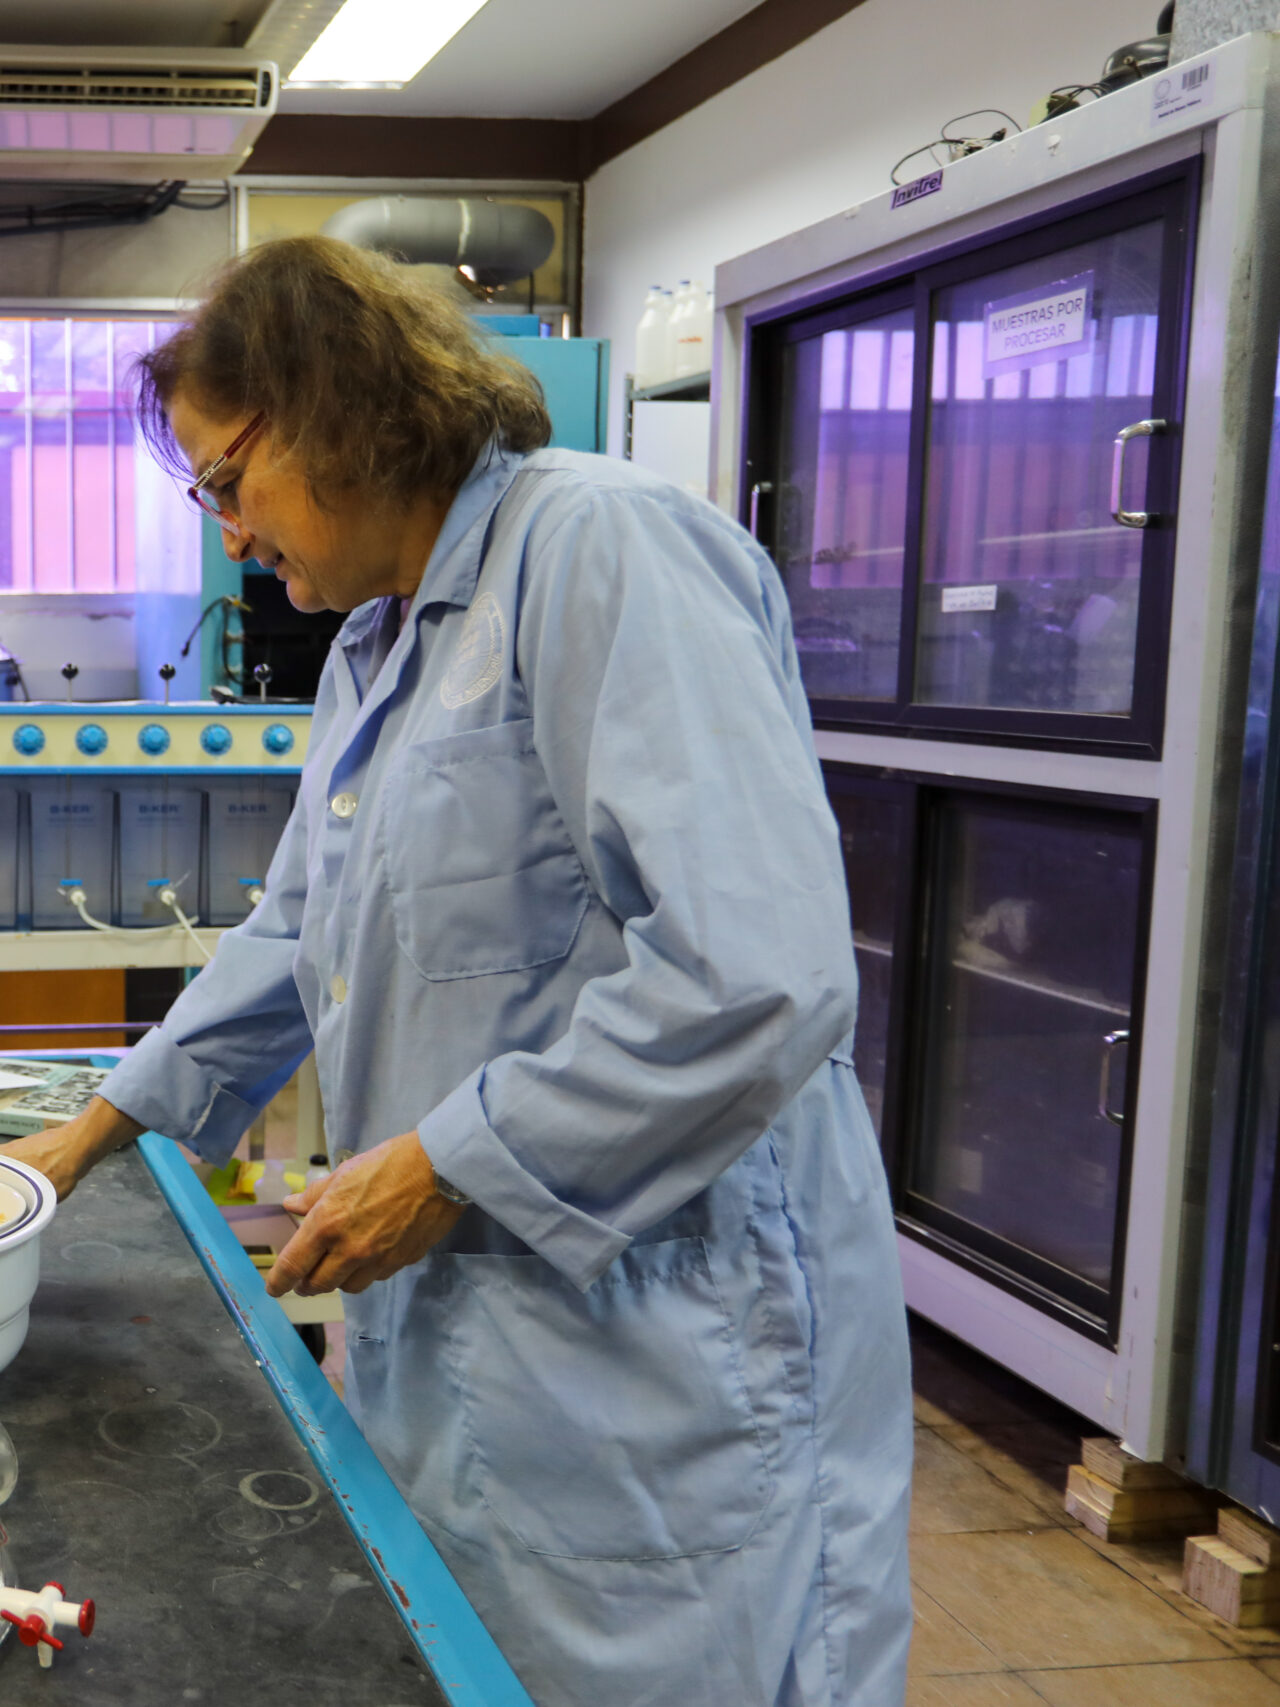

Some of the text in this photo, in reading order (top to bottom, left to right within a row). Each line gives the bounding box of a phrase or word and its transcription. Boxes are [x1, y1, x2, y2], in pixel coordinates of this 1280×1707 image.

[991, 297, 1083, 334] MUESTRAS POR
[1004, 323, 1066, 350] PROCESAR
